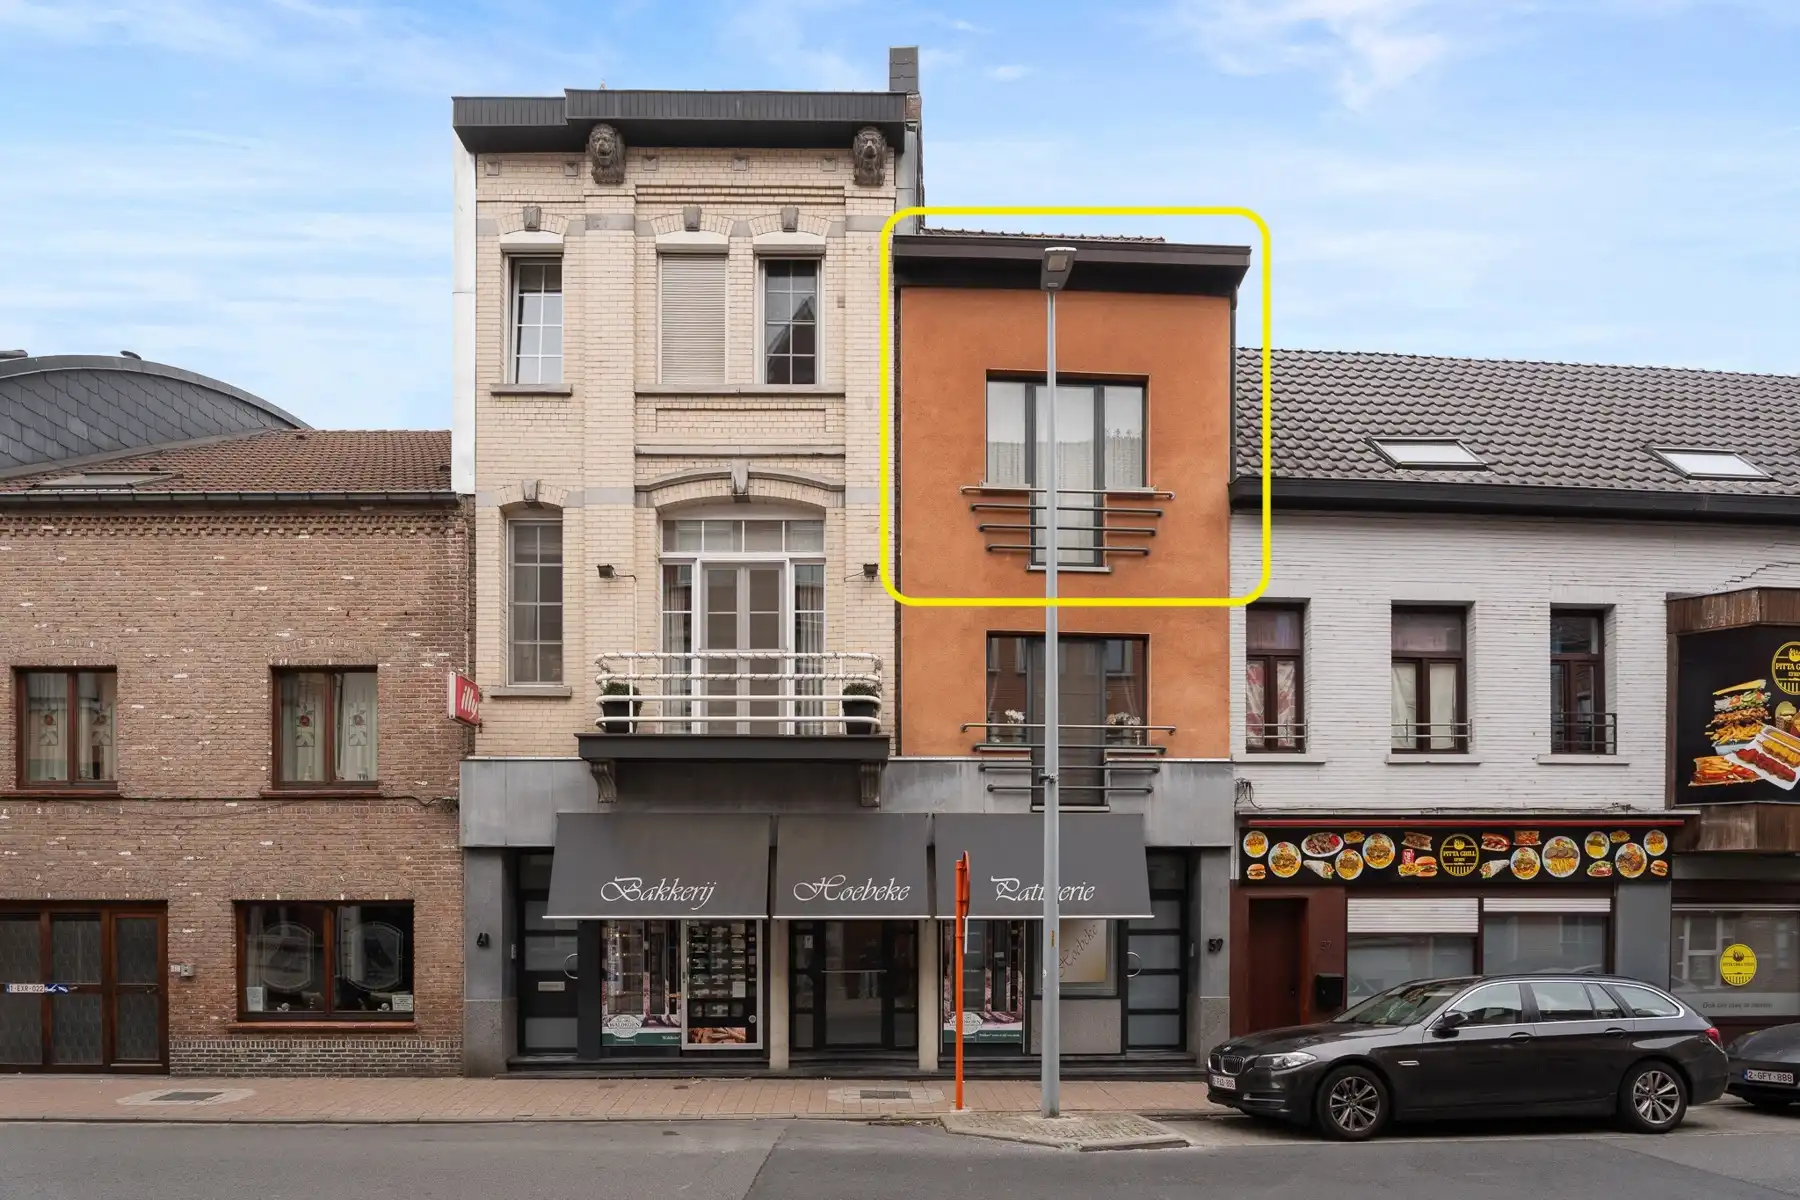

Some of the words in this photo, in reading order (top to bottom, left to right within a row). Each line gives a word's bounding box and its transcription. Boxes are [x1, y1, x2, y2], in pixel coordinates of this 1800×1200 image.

[1776, 662, 1794, 670] PITTA
[461, 685, 478, 719] illy
[600, 876, 717, 911] Bakkerij
[793, 874, 911, 901] Hoebeke
[990, 875, 1096, 902] Patierie
[1208, 938, 1223, 953] 59
